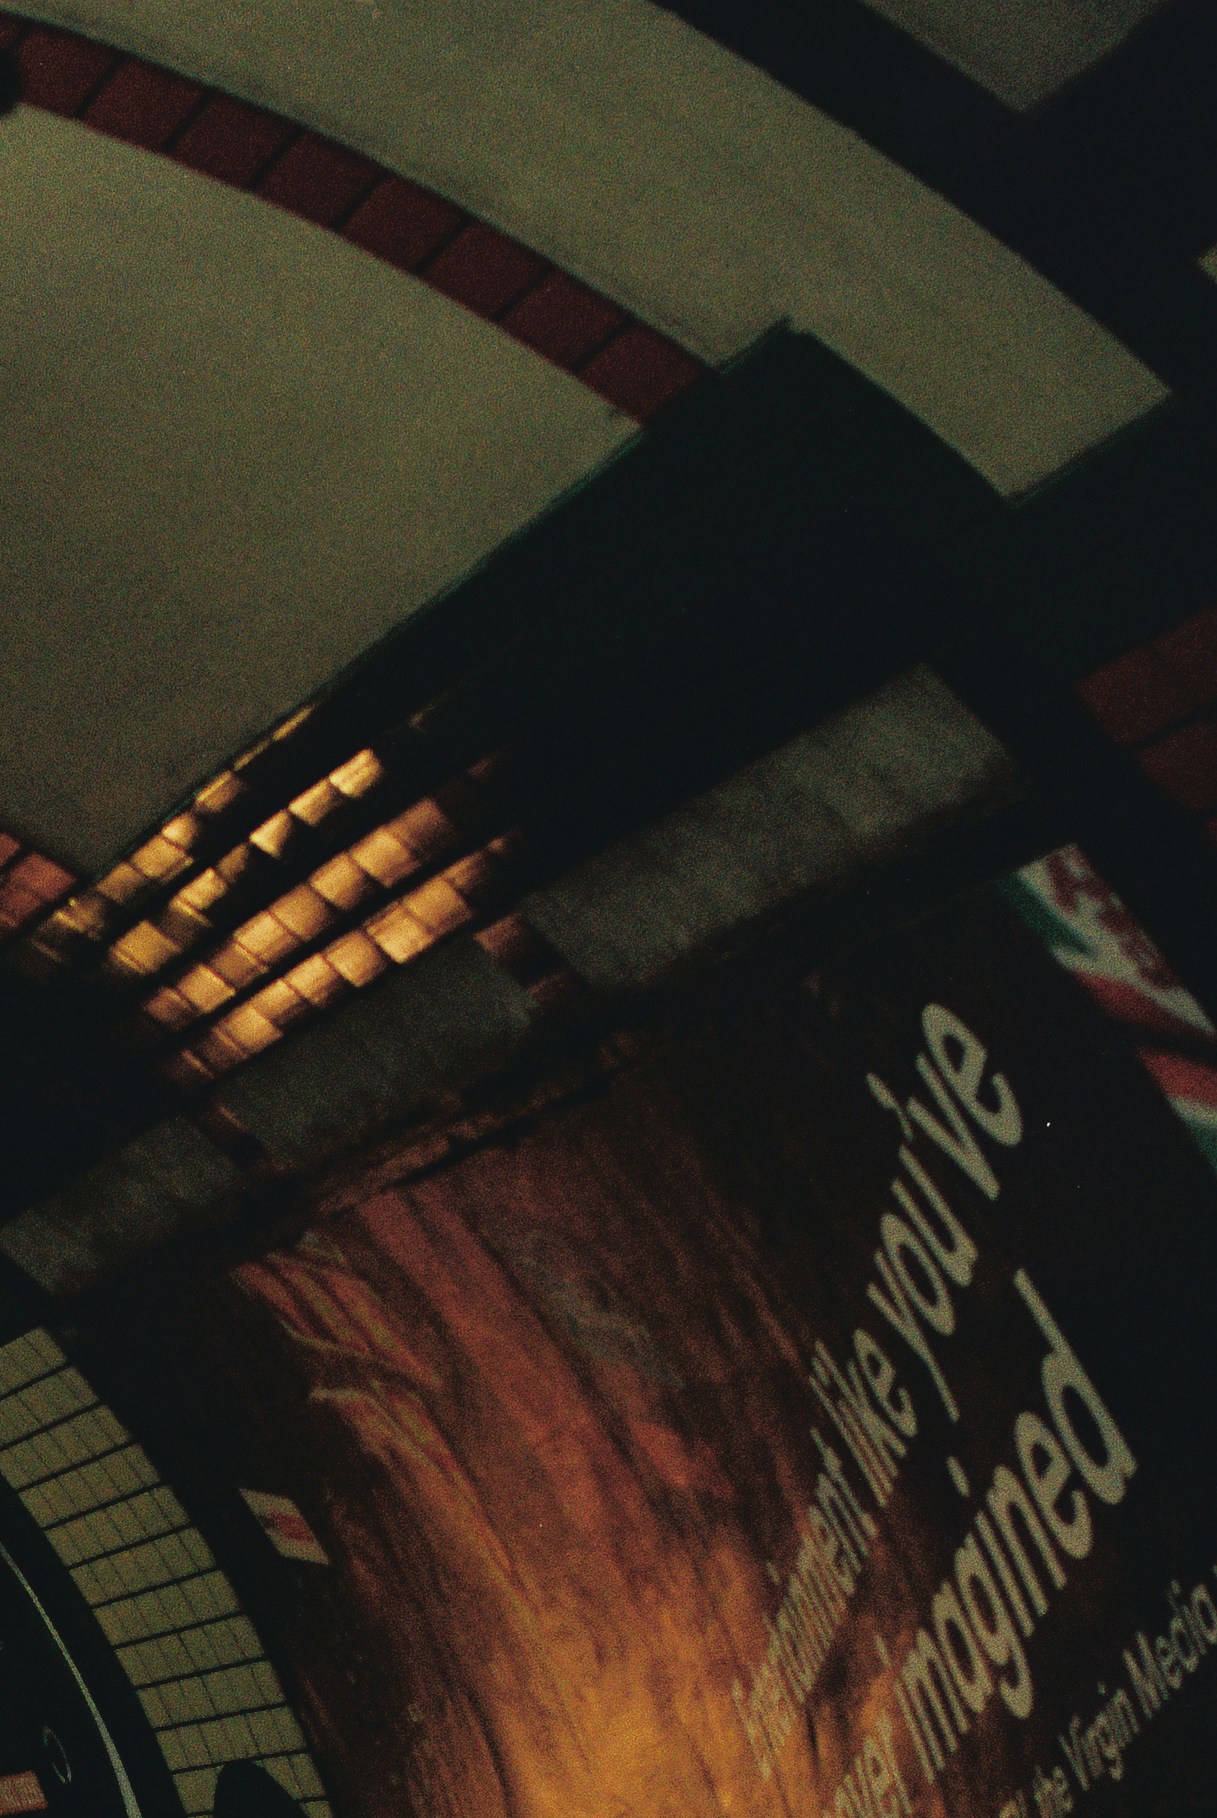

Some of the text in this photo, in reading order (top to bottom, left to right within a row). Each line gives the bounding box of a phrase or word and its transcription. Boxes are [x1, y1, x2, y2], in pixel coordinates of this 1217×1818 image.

[809, 1340, 917, 1507] like
[865, 1001, 1024, 1423] you've
[875, 1266, 1139, 1786] imagined
[1058, 1681, 1140, 1792] Virgin
[1122, 1579, 1217, 1721] Media
